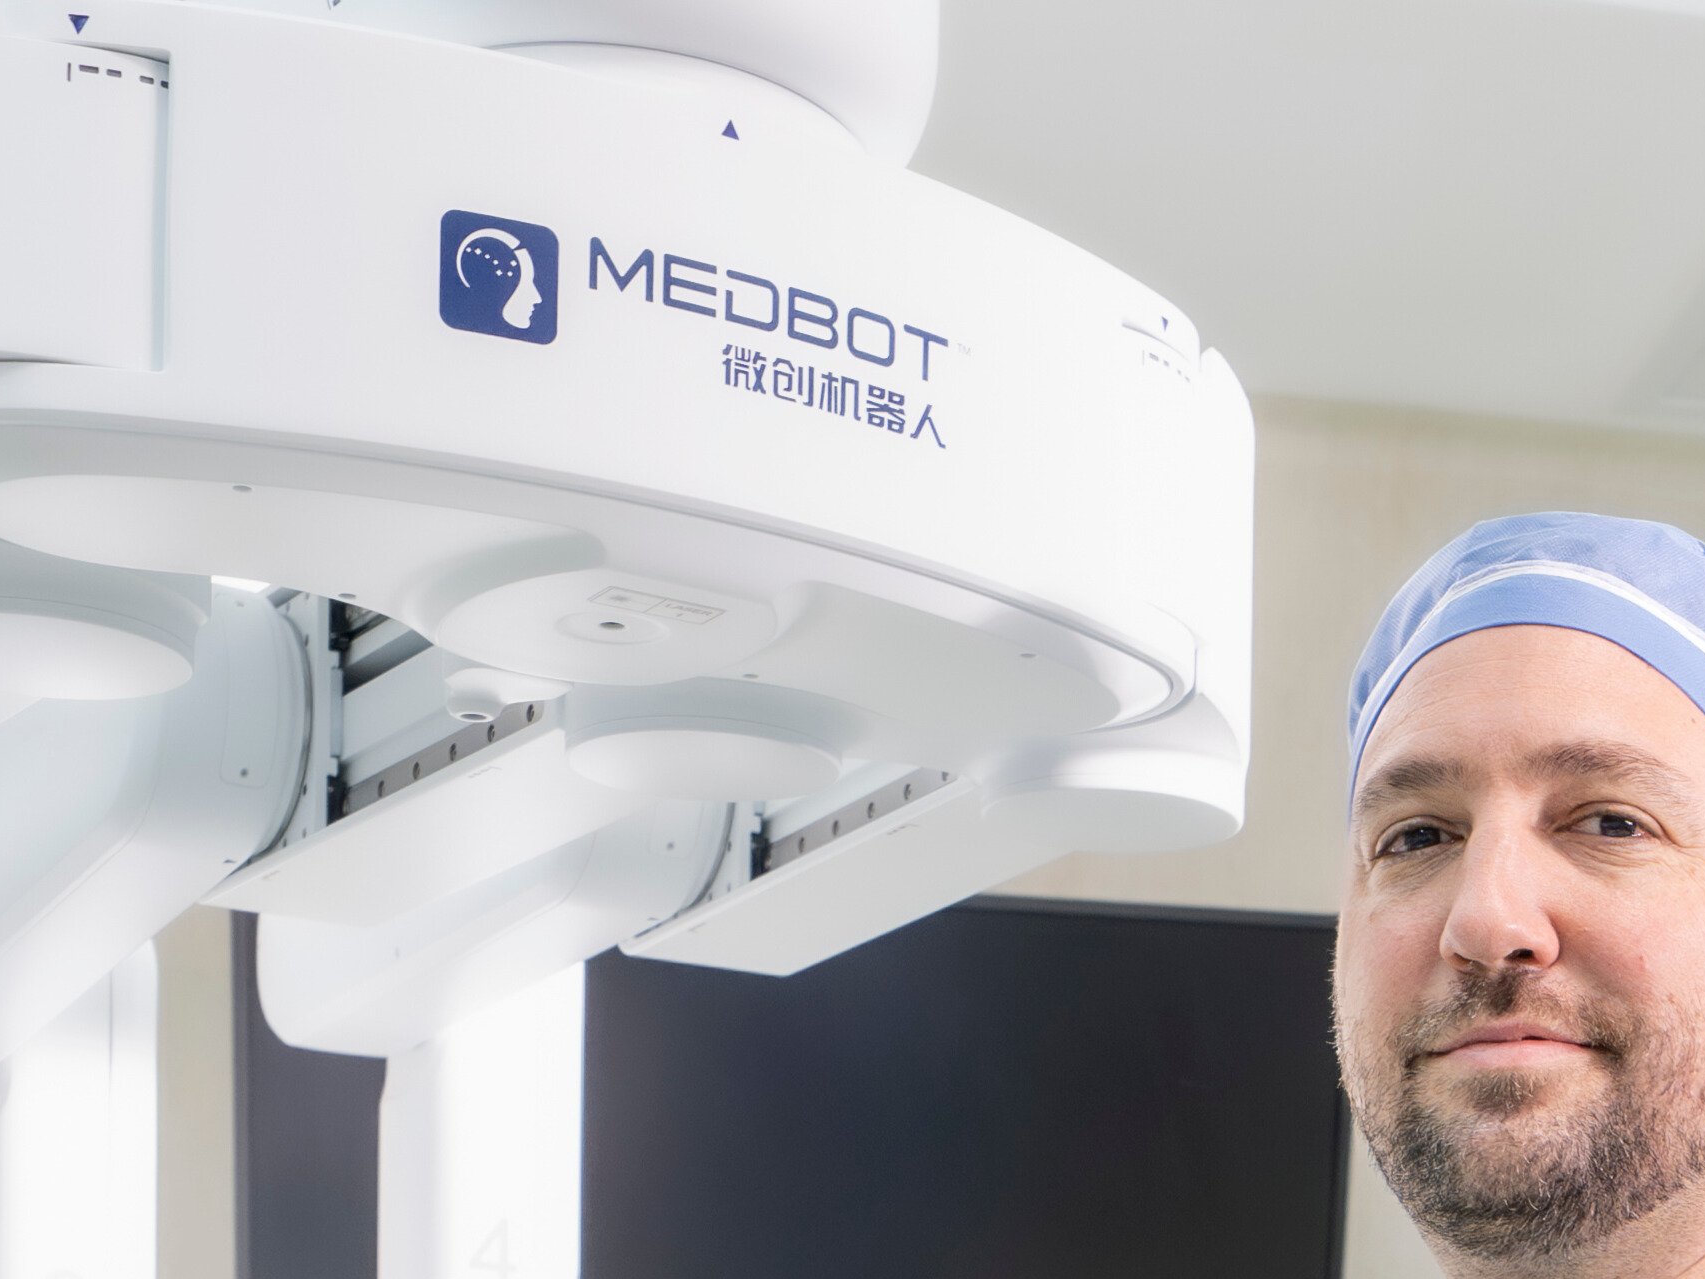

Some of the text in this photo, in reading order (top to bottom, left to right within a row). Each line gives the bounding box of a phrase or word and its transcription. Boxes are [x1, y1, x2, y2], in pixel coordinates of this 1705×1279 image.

[588, 235, 949, 381] MEDBOT
[721, 343, 947, 449] 微创机器人
